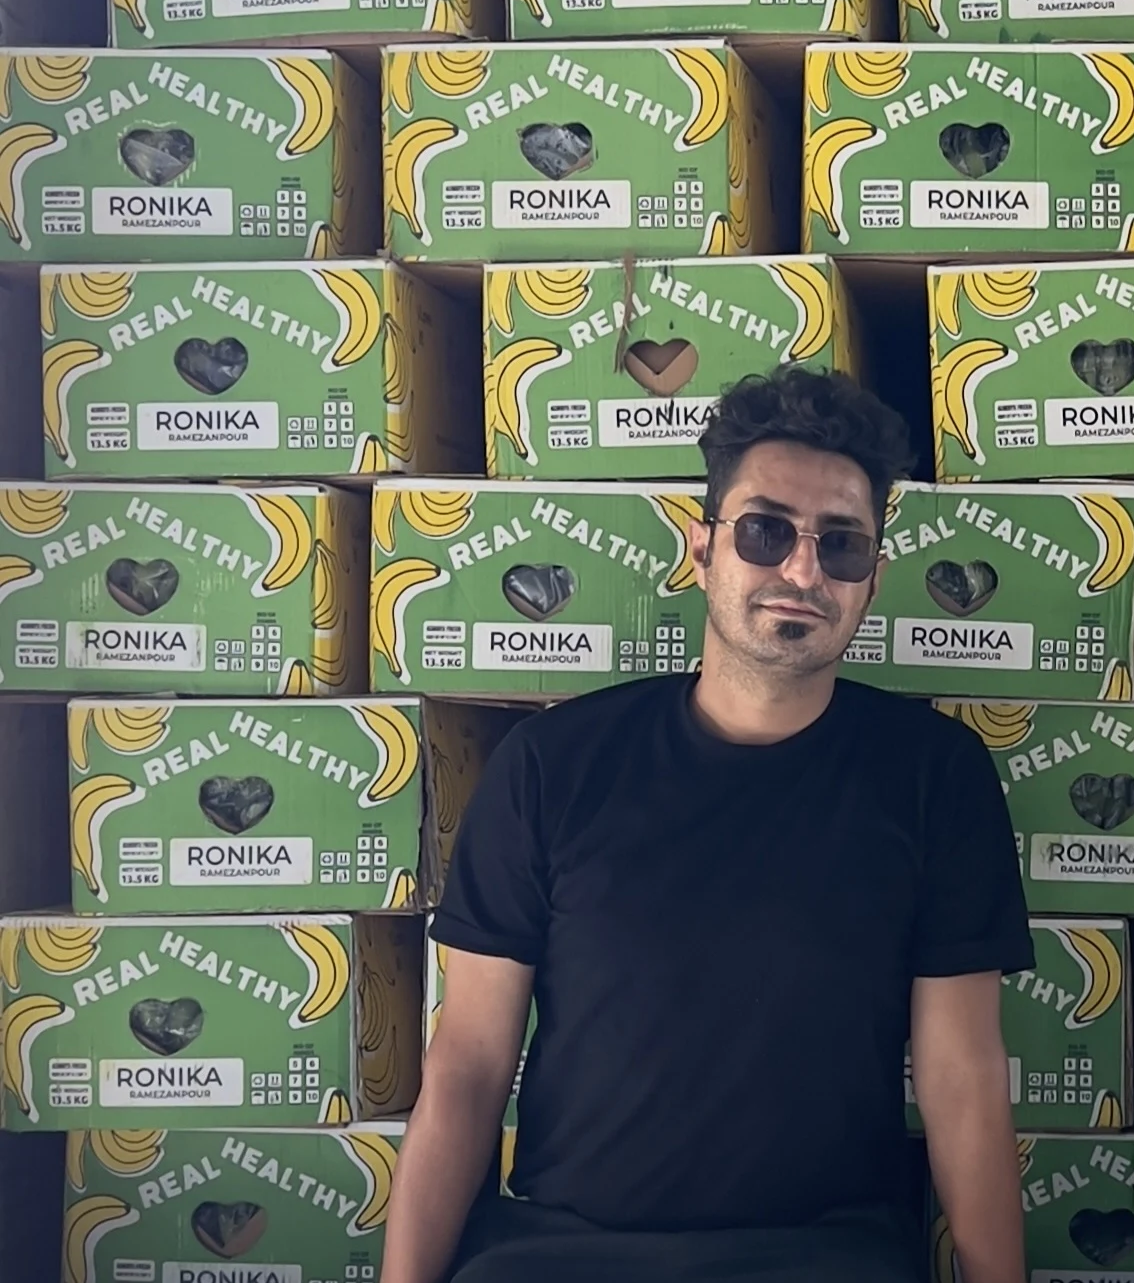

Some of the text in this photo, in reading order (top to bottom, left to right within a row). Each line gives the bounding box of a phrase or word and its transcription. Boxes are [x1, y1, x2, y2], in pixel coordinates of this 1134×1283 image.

[1037, 0, 1116, 13] RAMEZANPOUR
[63, 61, 288, 144] REAL HEALTHY
[464, 54, 685, 135] REAL HEALTHY
[883, 56, 1102, 138] REAL HEALTHY
[109, 195, 213, 218] RONIKA
[509, 187, 611, 211] RONIKA
[928, 188, 1029, 211] RONIKA
[521, 210, 601, 222] RAMEZANPOUR
[940, 211, 1019, 222] RAMEZANPOUR
[108, 276, 333, 356] REAL HEALTHY
[649, 271, 790, 351] HEALTHY
[1013, 293, 1097, 349] REAL
[155, 408, 260, 432] RONIKA
[615, 404, 719, 430] RONIKA
[168, 431, 249, 443] RAMEZANPOUR
[41, 497, 263, 580] REAL HEALTHY
[447, 497, 669, 581] REAL HEALTHY
[955, 496, 1090, 581] HEALTHY
[84, 628, 187, 652] RONIKA
[490, 630, 592, 653] RONIKA
[911, 626, 1013, 651] RONIKA
[502, 653, 581, 664] RAMEZANPOUR
[142, 710, 370, 791] REAL HEALTHY
[1007, 730, 1091, 782] REAL
[188, 843, 292, 868] RONIKA
[142, 873, 159, 885] KG
[200, 866, 281, 878] RAMEZANPOUR
[72, 930, 301, 1012] REAL HEALTHY
[117, 1065, 223, 1089] RONIKA
[129, 1088, 212, 1100] RAMEZANPOUR
[137, 1136, 358, 1220] REAL HEALTHY
